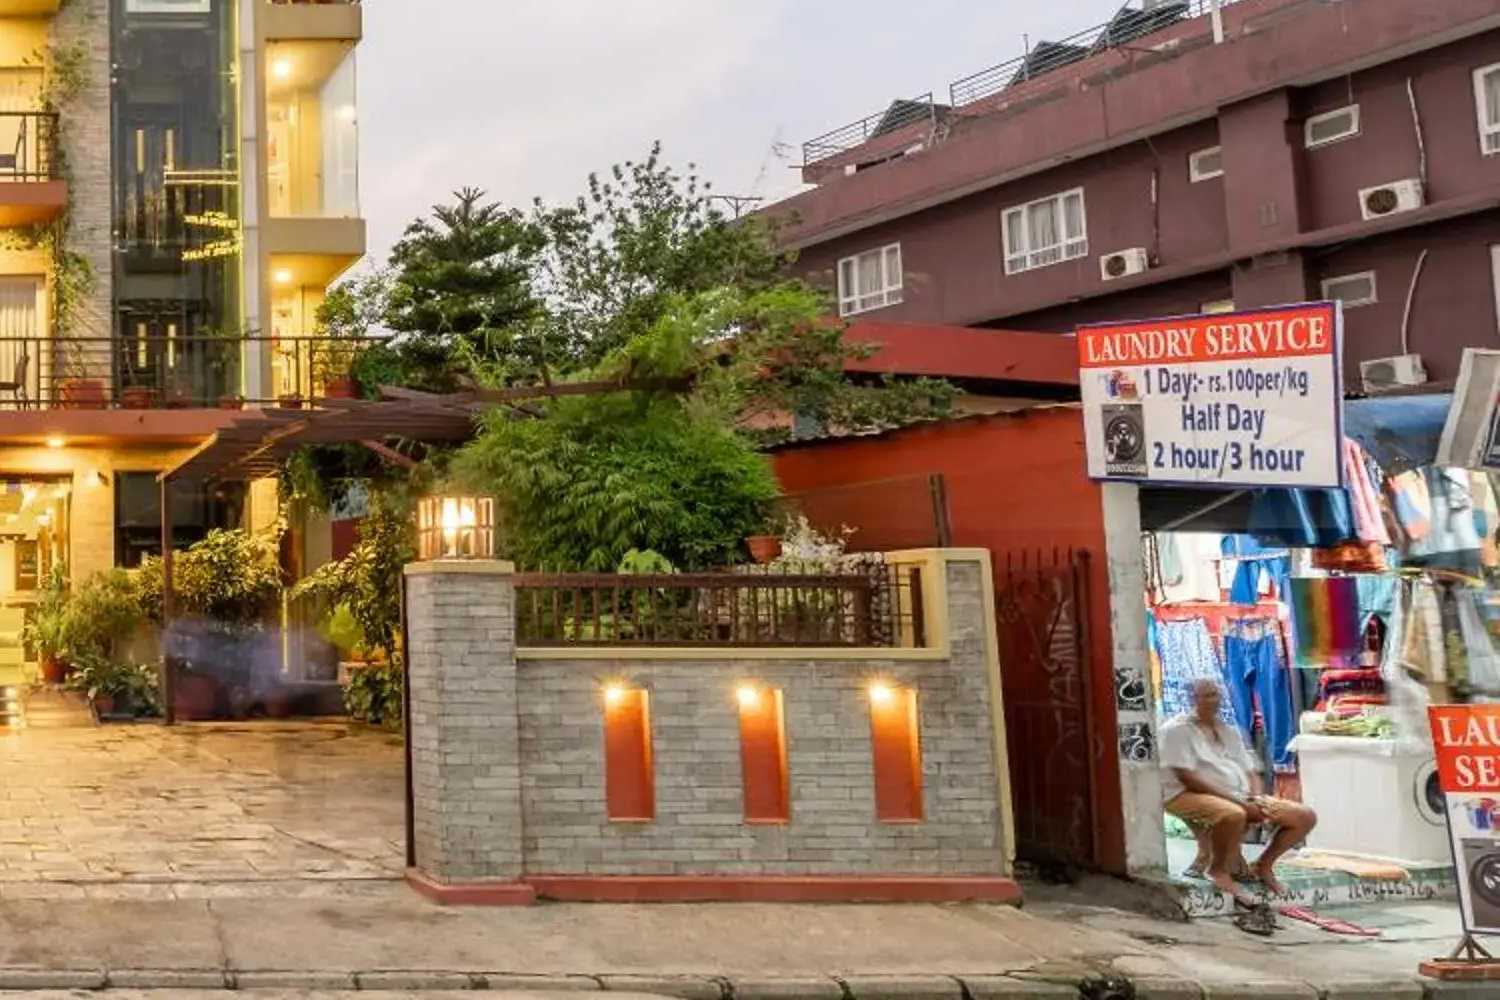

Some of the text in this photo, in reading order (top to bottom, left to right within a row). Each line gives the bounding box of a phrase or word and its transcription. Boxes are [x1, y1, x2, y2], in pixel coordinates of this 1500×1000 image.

[1085, 316, 1326, 363] LAUNDRY SERVICE
[1143, 368, 1151, 395] 1
[1182, 403, 1265, 440] Half Day
[1153, 442, 1165, 468] 2
[1250, 442, 1305, 471] hour
[1455, 755, 1500, 787] SE
